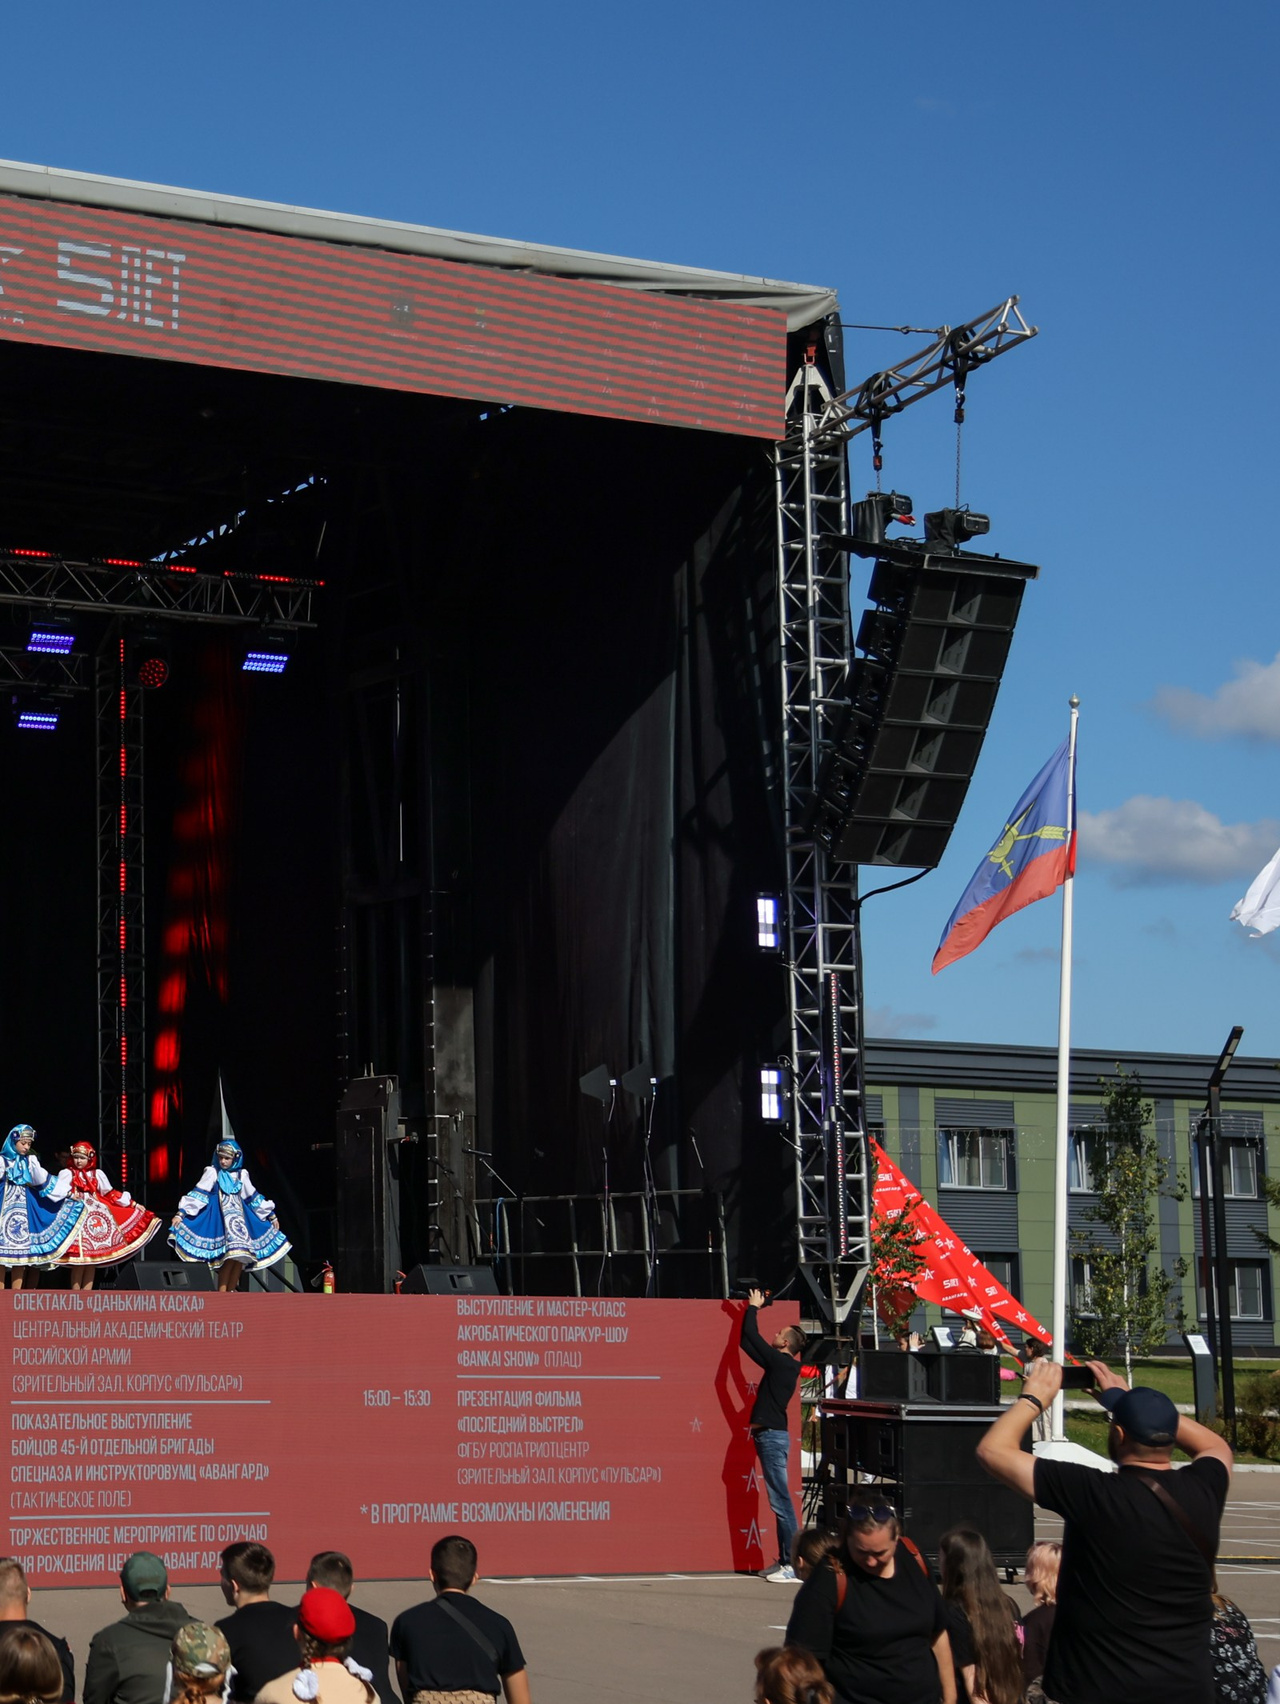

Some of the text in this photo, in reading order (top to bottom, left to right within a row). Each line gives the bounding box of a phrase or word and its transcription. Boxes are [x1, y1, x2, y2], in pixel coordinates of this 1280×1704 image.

[13, 1294, 205, 1313] СПЕКТАКЛЬ «ДАНЬКИНА КАСКА»
[457, 1300, 626, 1317] ВЫСТУПЛЕНИЕ И МАСТЕР-КЛАСС
[13, 1318, 243, 1340] ЦЕНТРАЛЬНЫЙ АКАДЕМИЧЕСКИЙ ТЕАТР
[457, 1326, 628, 1342] АКРОБАТИЧЕСКОГО ПАРКУР-ШОУ
[12, 1345, 131, 1366] РОССИЙСКОЙ АРМИИ
[457, 1351, 582, 1368] «BANKAI SHOW» (ПЛАЦ)
[13, 1372, 94, 1393] (ЗРИТЕЛЬНЫЙ
[127, 1374, 172, 1392] КОРПУС
[174, 1374, 242, 1391] «ПУЛЬСАР»)
[363, 1390, 390, 1406] 15:00
[403, 1390, 430, 1406] 15:30
[457, 1391, 581, 1408] ПРЕЗЕНТАЦИЯ ФИЛЬМА
[12, 1413, 192, 1430] ПОКАЗАТЕЛЬНОЕ ВЫСТУПЛЕНИЕ
[458, 1413, 583, 1434] «ПОСЛЕДНИЙ ВЫСТРЕЛ»
[11, 1435, 214, 1458] БОЙЦОВ 45-Й ОТДЕЛЬНОЙ БРИГАДЫ
[457, 1442, 589, 1459] ФГБУ РОСПАТРИОТЦЕНТР
[11, 1463, 269, 1484] СПЕЦНАЗА И ИНСТРУКТОРОВУМЦ «АВАНГАРД»
[457, 1466, 530, 1485] (ЗРИТЕЛЬНЫЙ
[559, 1467, 598, 1484] КОРПУС
[600, 1467, 661, 1483] «ПУЛЬСАР»)
[11, 1490, 131, 1509] (ТАКТИЧЕСКОЕ ПОЛЕ)
[371, 1502, 610, 1524] В ПРОГРАММЕ ВОЗМОЖНЫ ИЗМЕНЕНИЯ
[10, 1523, 268, 1546] ТОРЖЕСТВЕННОЕ МЕРОПРИЯТИЕ ПО СЛУЧАЮ
[38, 1553, 105, 1574] РОЖДЕНИЯ
